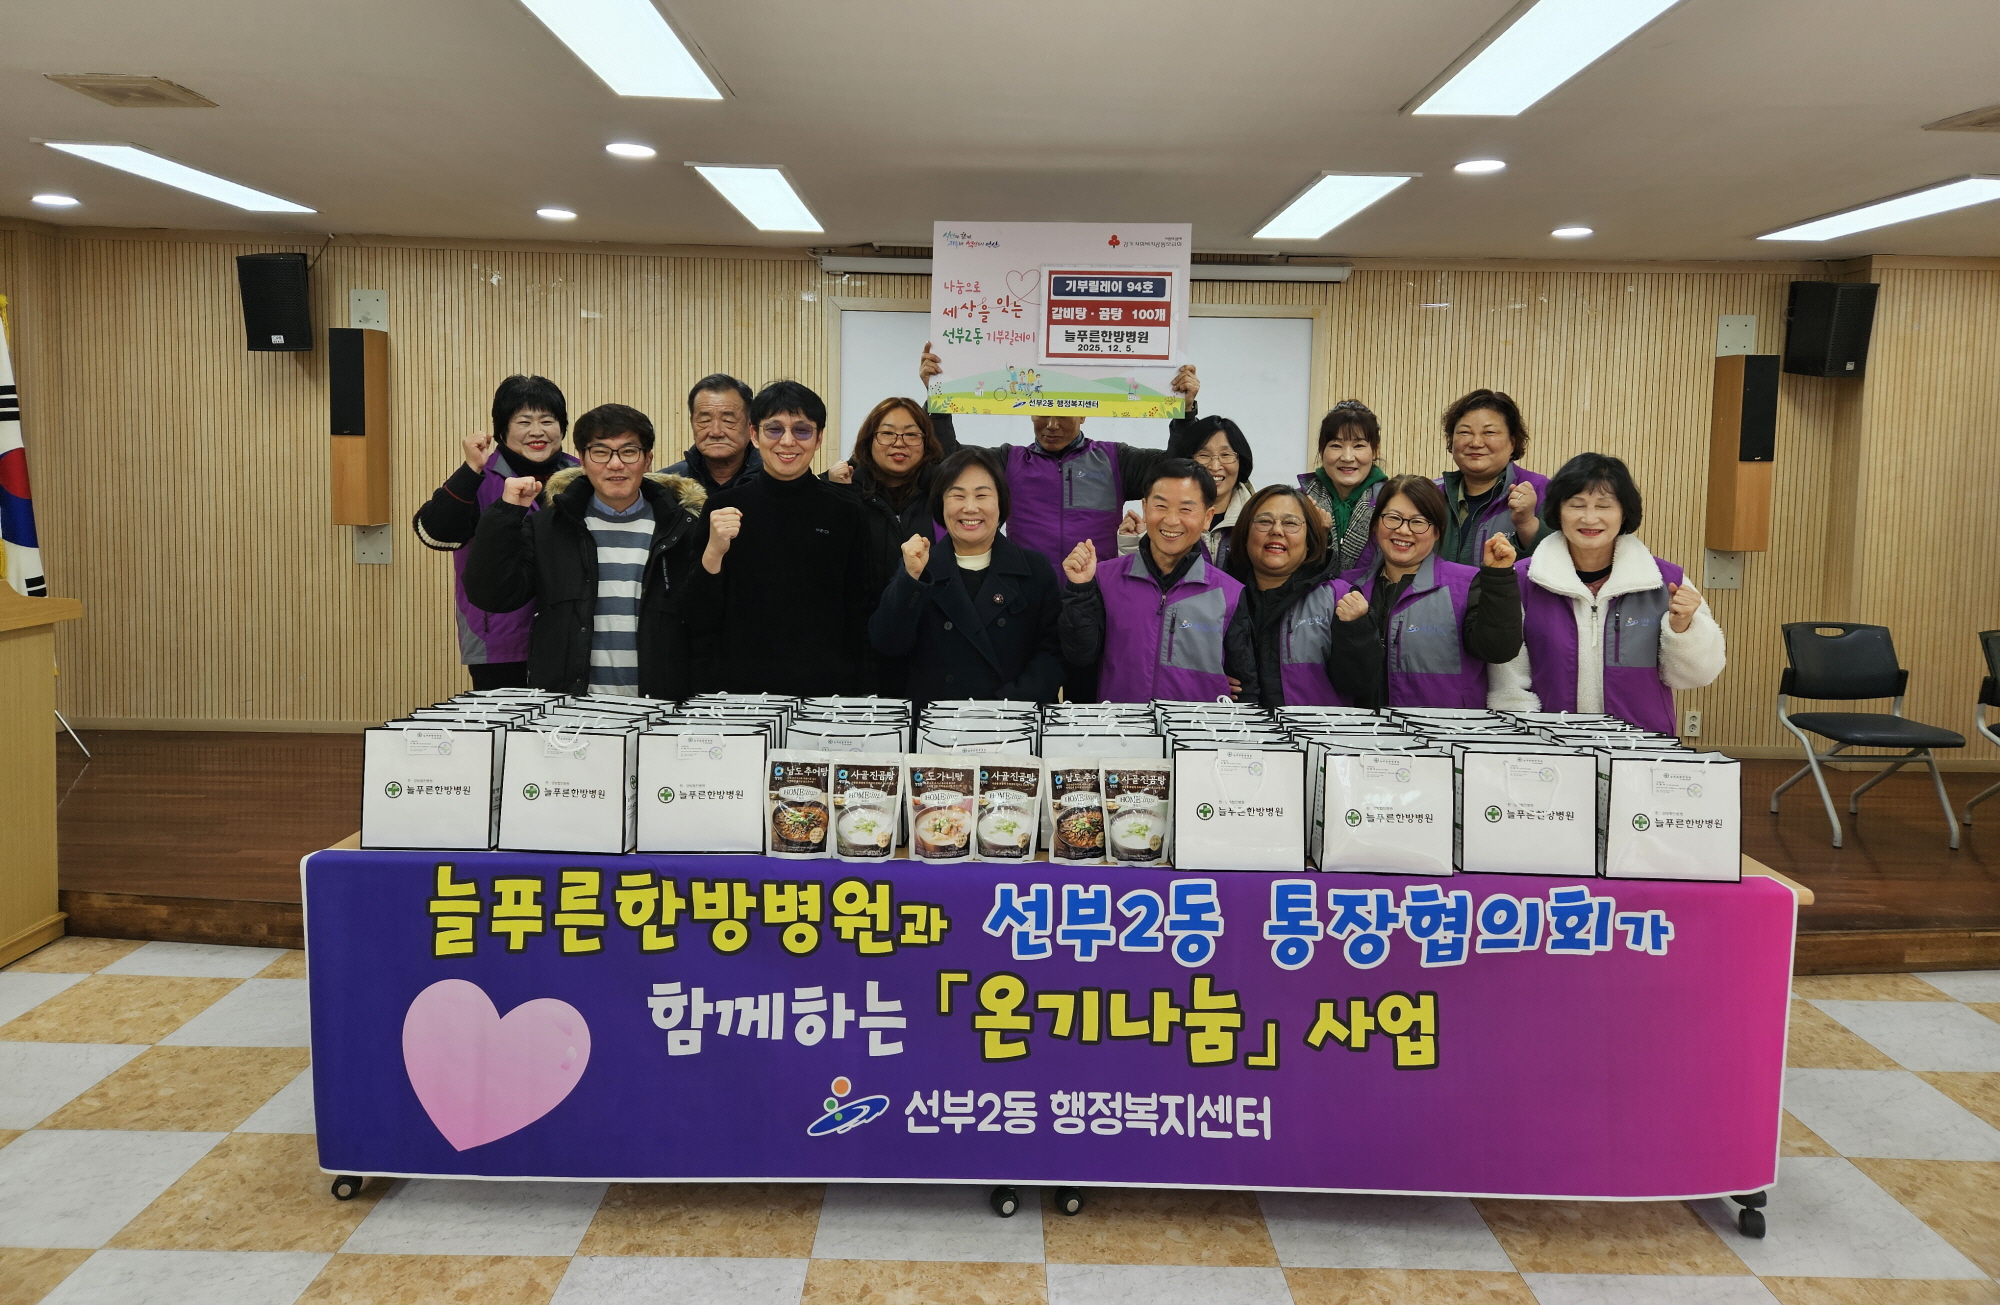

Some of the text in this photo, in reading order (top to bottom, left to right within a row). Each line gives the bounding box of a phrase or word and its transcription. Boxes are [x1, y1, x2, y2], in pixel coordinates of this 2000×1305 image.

[944, 280, 981, 294] 나눔으로
[1065, 280, 1154, 293] 기부릴레이 94호
[943, 295, 1023, 323] 세상을 잇는
[1051, 307, 1087, 320] 갈비탕
[1099, 308, 1123, 320] 곰탕
[1132, 309, 1166, 321] 100개
[943, 327, 1035, 345] 선부2동 기부릴레이
[1065, 330, 1149, 343] 늘푸른한방병원
[1077, 344, 1135, 353] 2025. 12. 5.
[1029, 400, 1099, 408] 선부2동 행정복지센터
[787, 766, 829, 777] 남도추어탕
[851, 770, 895, 781] 사골진곰탕
[926, 771, 964, 781] 도가니탕
[991, 771, 1037, 782] 사골진곰탕
[1065, 773, 1098, 782] 남도추
[1121, 775, 1166, 786] 사골진곰탕
[406, 785, 471, 795] 늘푸른한방병원
[544, 787, 606, 799] 늘푸른한방병원
[679, 790, 744, 800] 늘푸른한방병원
[1366, 813, 1433, 824] 늘푸른한방병원
[1655, 818, 1723, 829] 늘푸른한방병원
[427, 864, 1675, 970] 늘푸른한방병원과 선부2동 통장협의회가
[647, 970, 1440, 1071] 함께하는 「온기나눔」 사업
[904, 1089, 1272, 1141] 선부2동 행정복지센터
